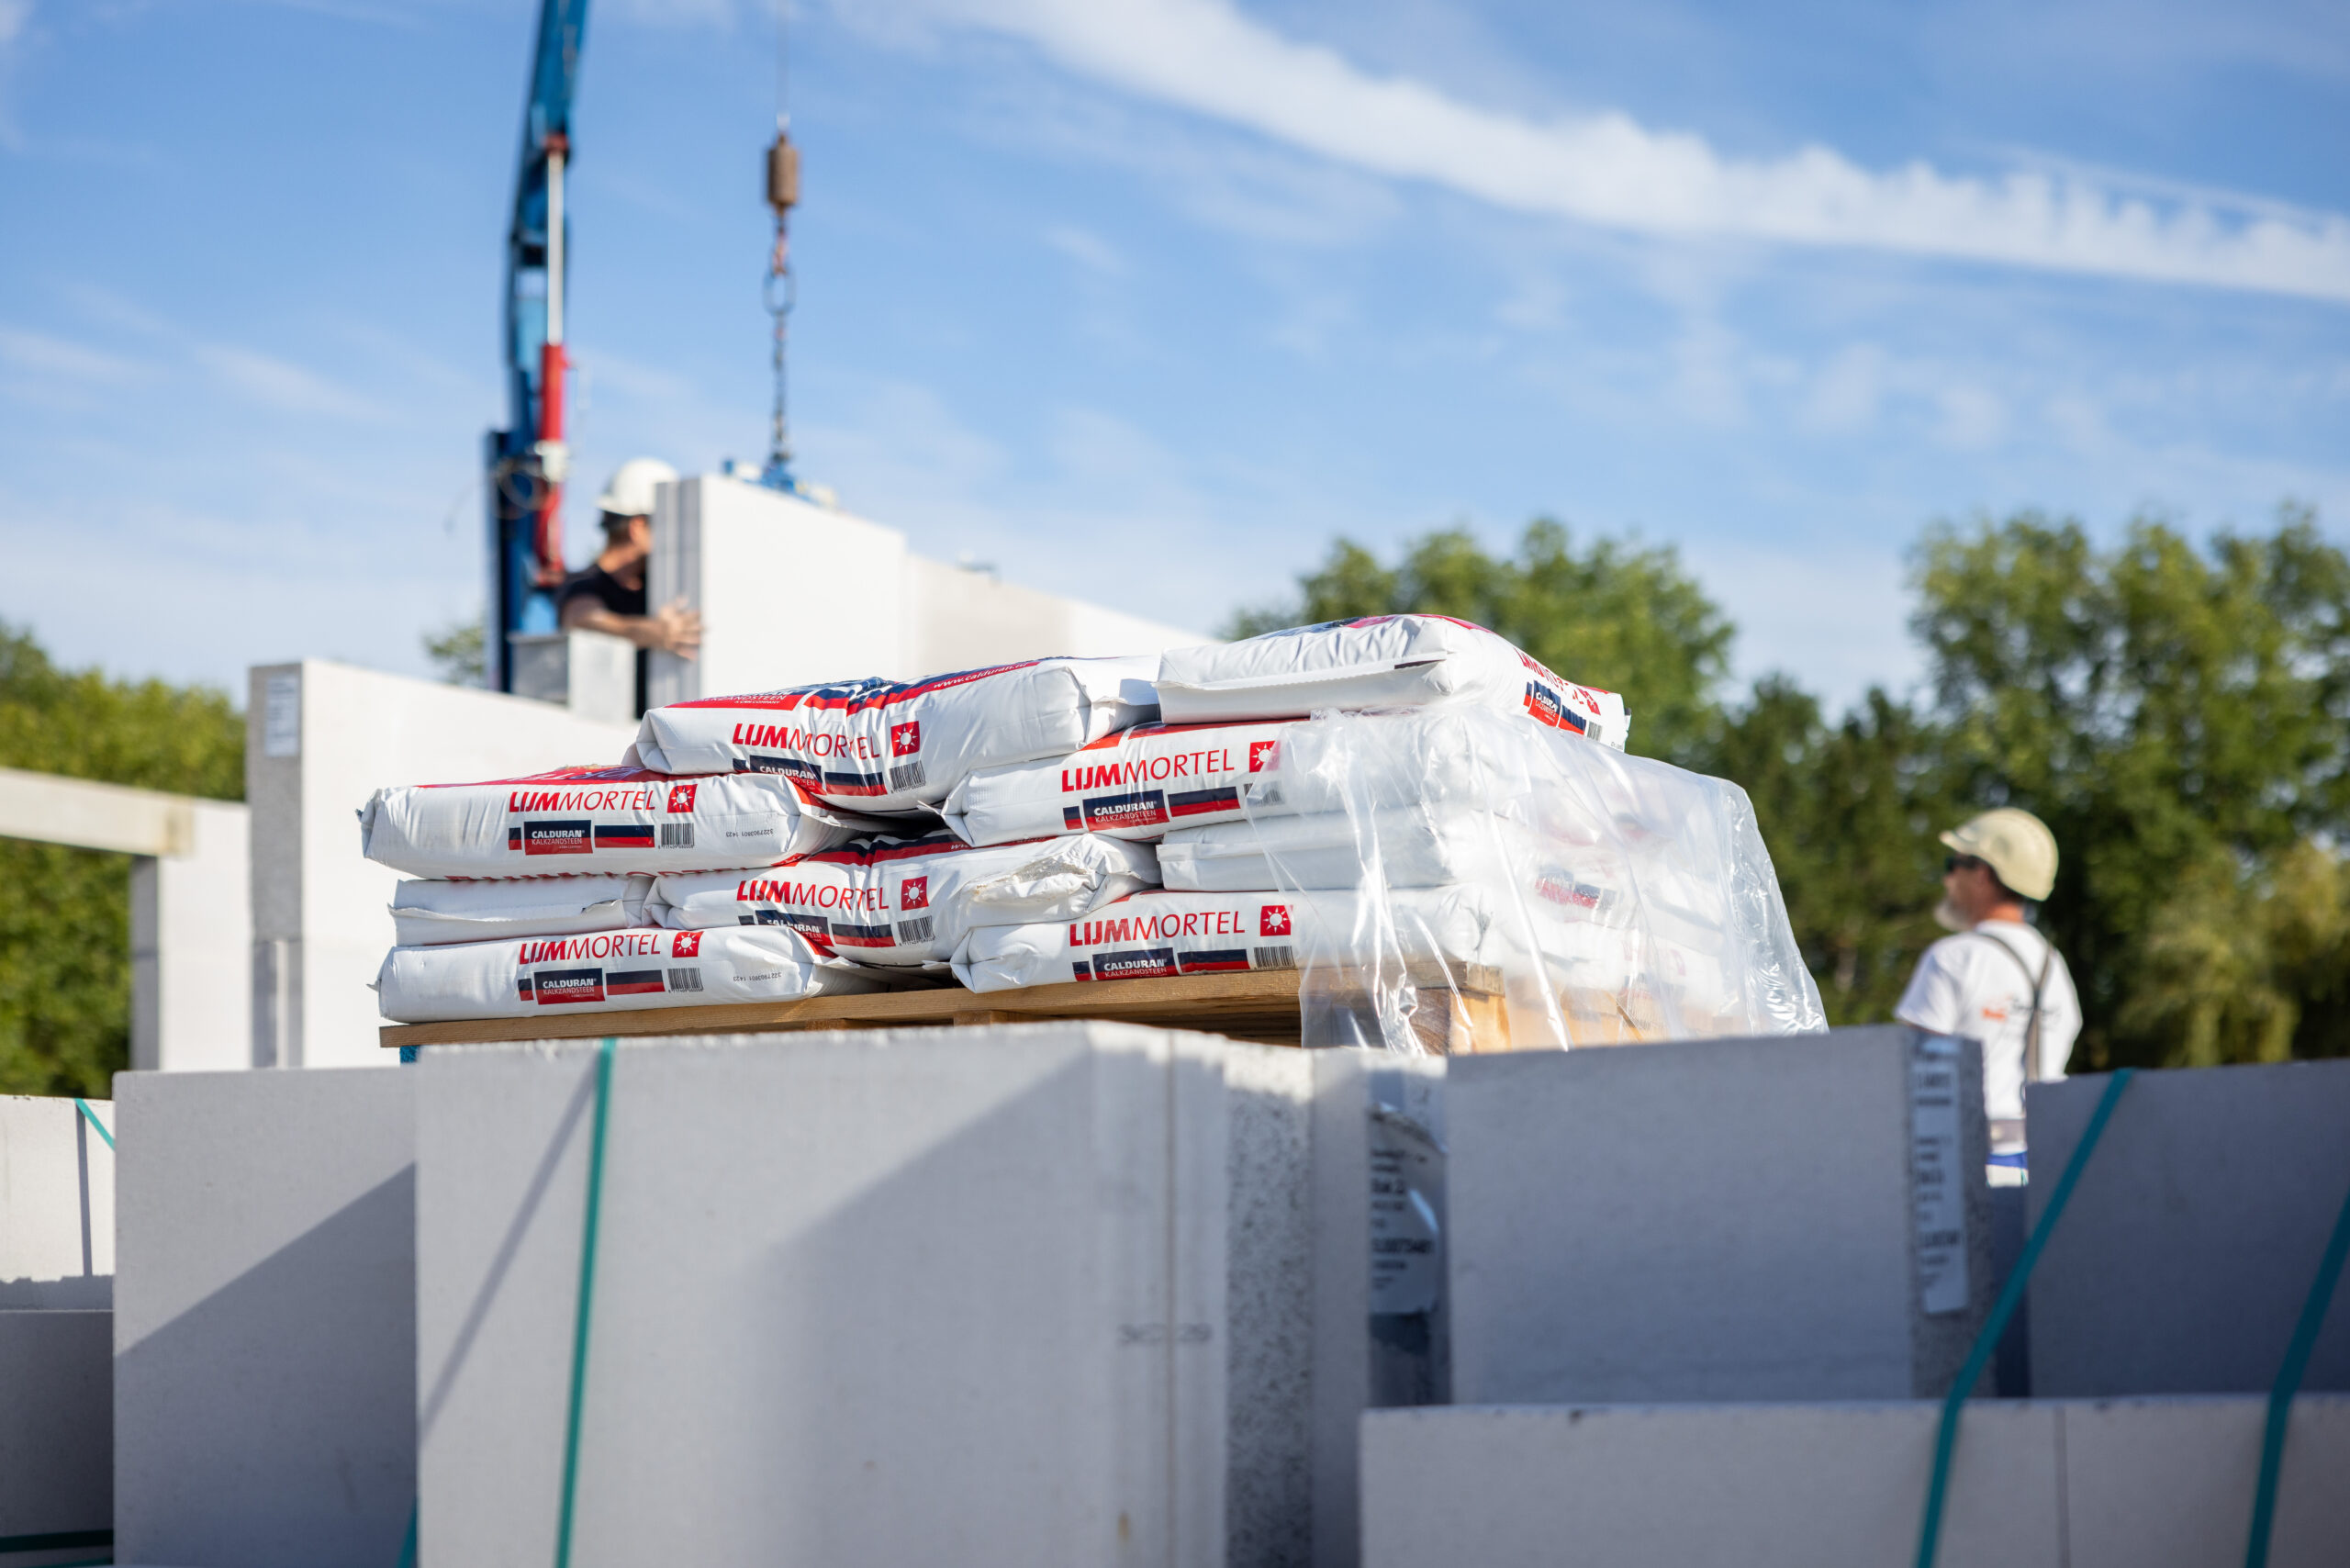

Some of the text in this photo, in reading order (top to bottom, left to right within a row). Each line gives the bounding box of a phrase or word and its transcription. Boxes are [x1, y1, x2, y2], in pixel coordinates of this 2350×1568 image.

[1062, 749, 1235, 792] LIJMMORTEL
[509, 790, 655, 812] LIJMMORTEL
[1095, 810, 1157, 823] KALKZANDSTEEN
[736, 880, 890, 912] LIJMMORTEL
[1069, 911, 1246, 947] LIJMMORTEL
[520, 934, 661, 965] LIJMMORTEL
[1105, 968, 1167, 978] KALKZANDSTEEN
[543, 986, 595, 995] KALKZANDSTEEN
